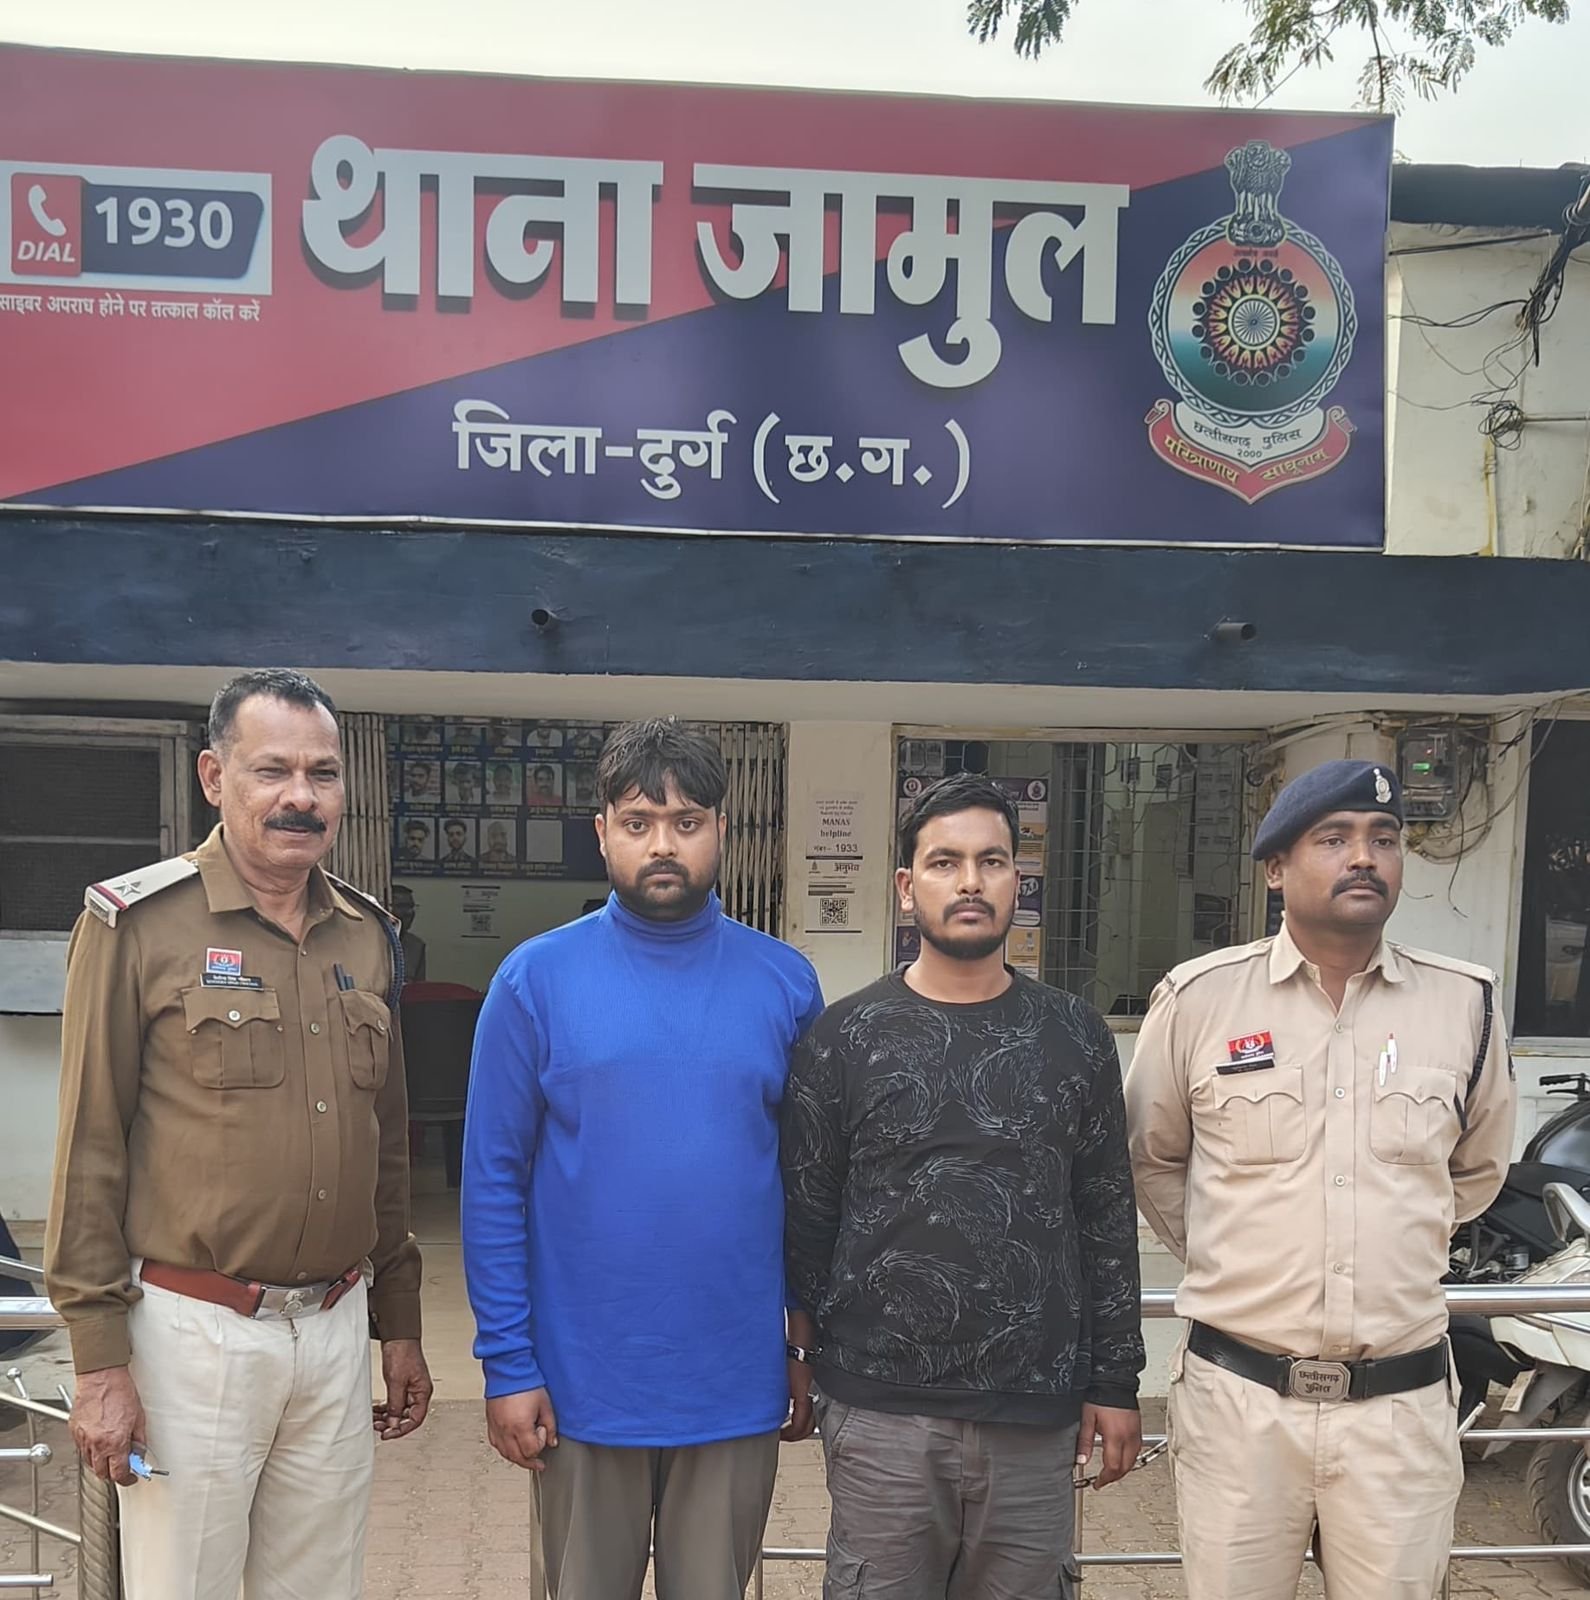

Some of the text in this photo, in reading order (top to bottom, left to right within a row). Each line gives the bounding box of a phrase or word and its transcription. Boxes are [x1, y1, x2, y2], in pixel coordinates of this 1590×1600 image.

[95, 196, 233, 250] 1930
[17, 240, 76, 263] DIAL
[302, 134, 1130, 388] थाना जामुल
[0, 292, 261, 321] साइबर अपराध होने पर तत्काल कॉल करें
[1262, 428, 1302, 450] पुलिस
[822, 818, 851, 826] MANAS
[835, 843, 858, 853] 1933
